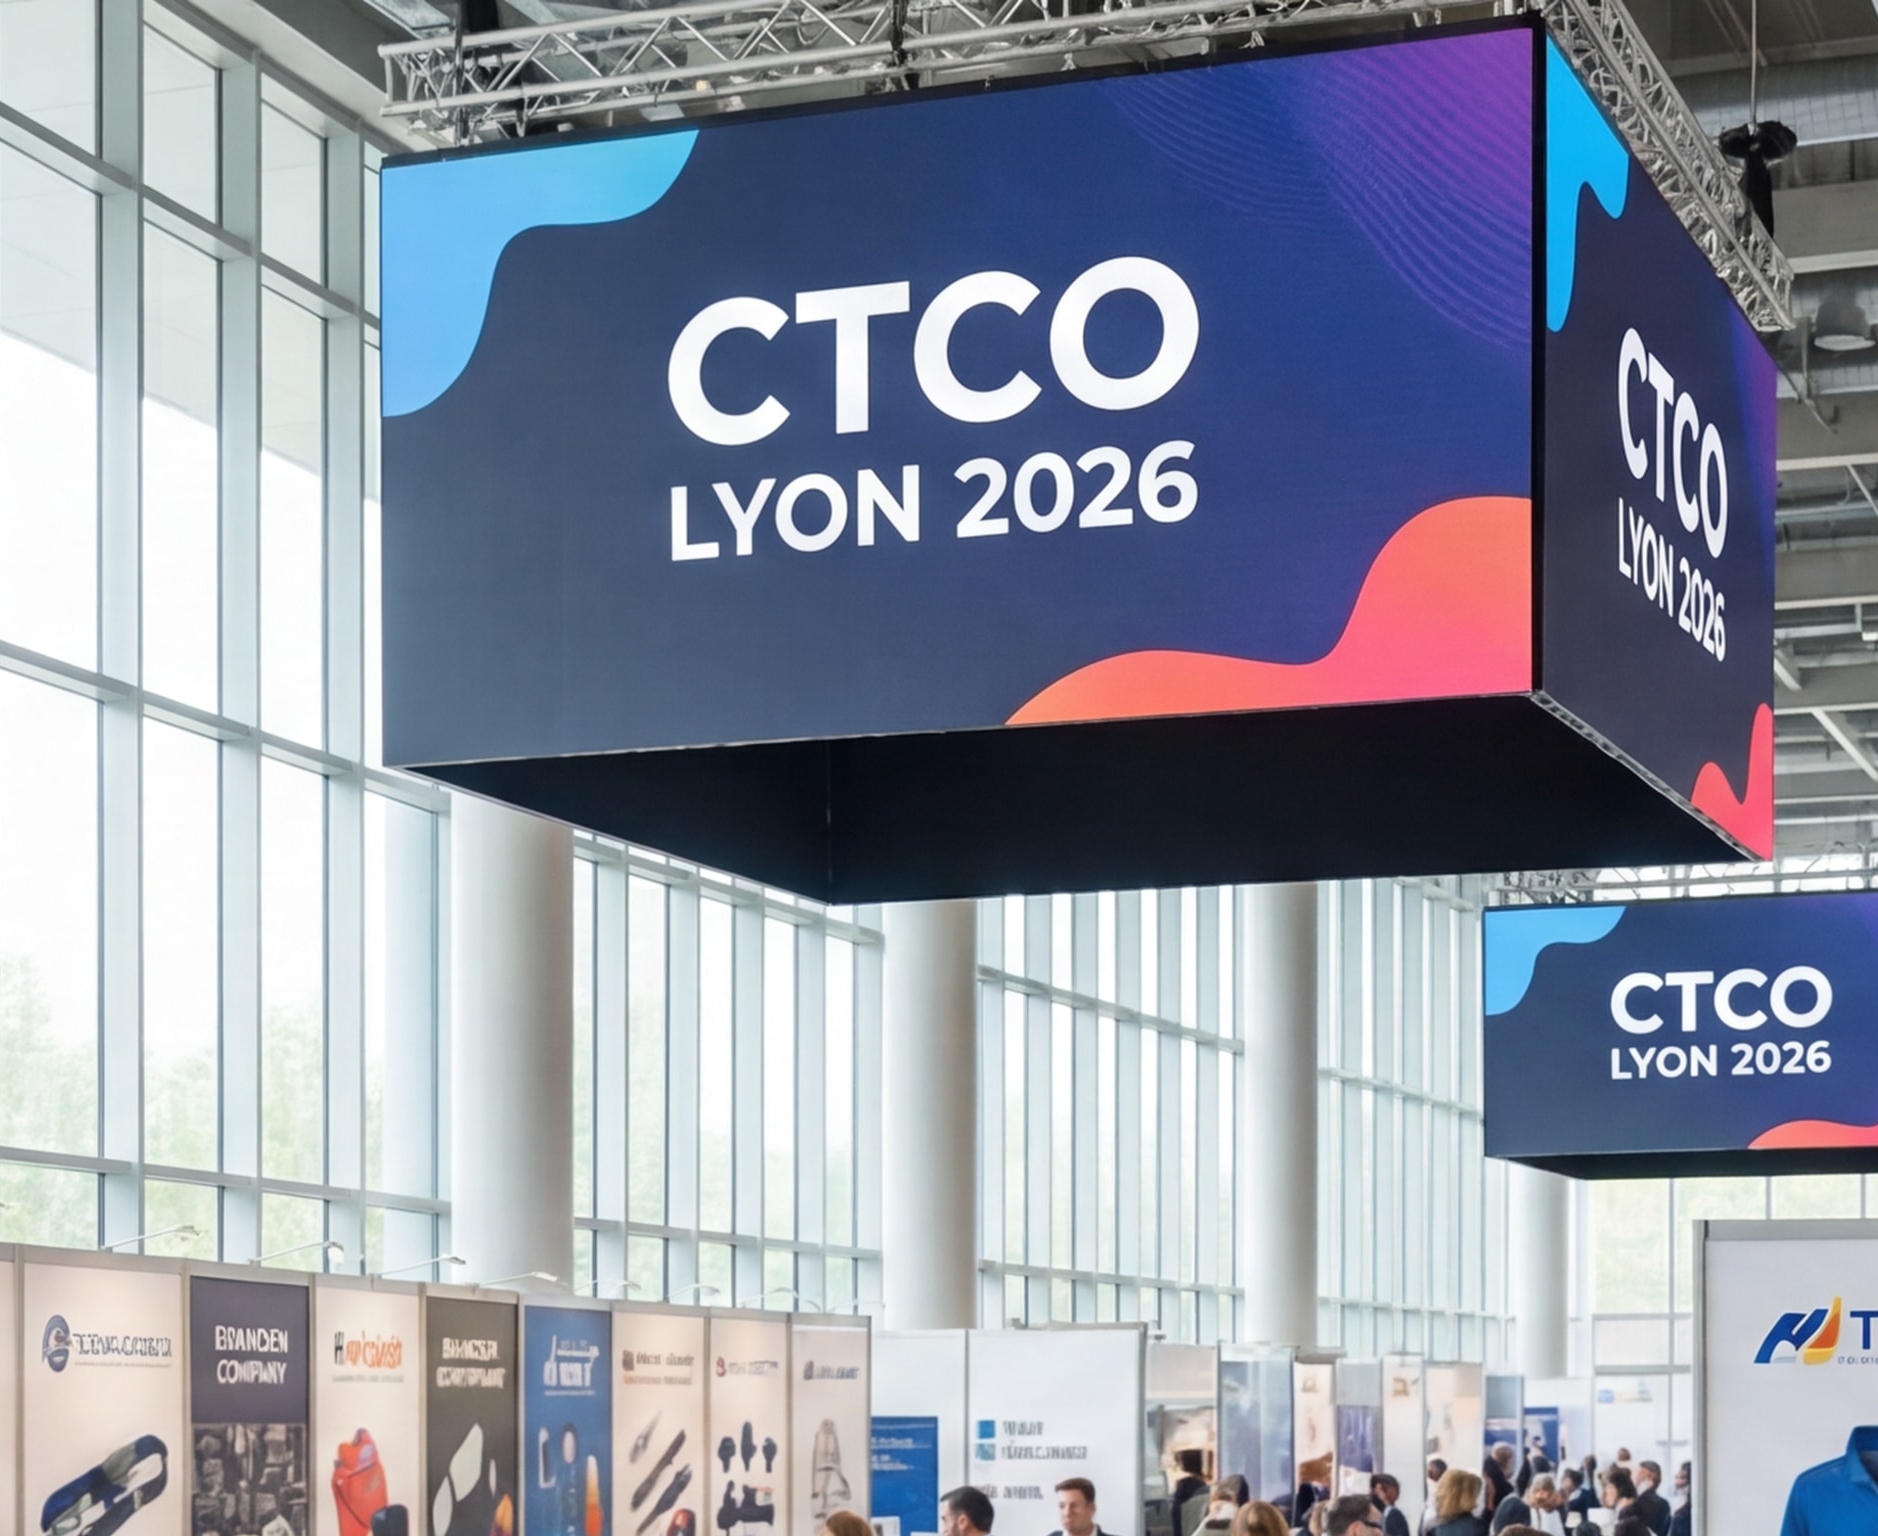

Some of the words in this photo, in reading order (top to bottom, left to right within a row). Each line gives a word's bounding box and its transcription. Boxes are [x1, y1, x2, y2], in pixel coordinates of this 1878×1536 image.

[667, 256, 1200, 446] CTCO
[671, 464, 920, 562] LYON
[953, 440, 1199, 539] 2026
[1618, 328, 1728, 559] CTCO
[1618, 497, 1674, 618] LYON
[1678, 557, 1726, 662] 2026
[1610, 966, 1833, 1035] CTCO
[1611, 1044, 1718, 1079] LYON
[1730, 1040, 1832, 1075] 2026
